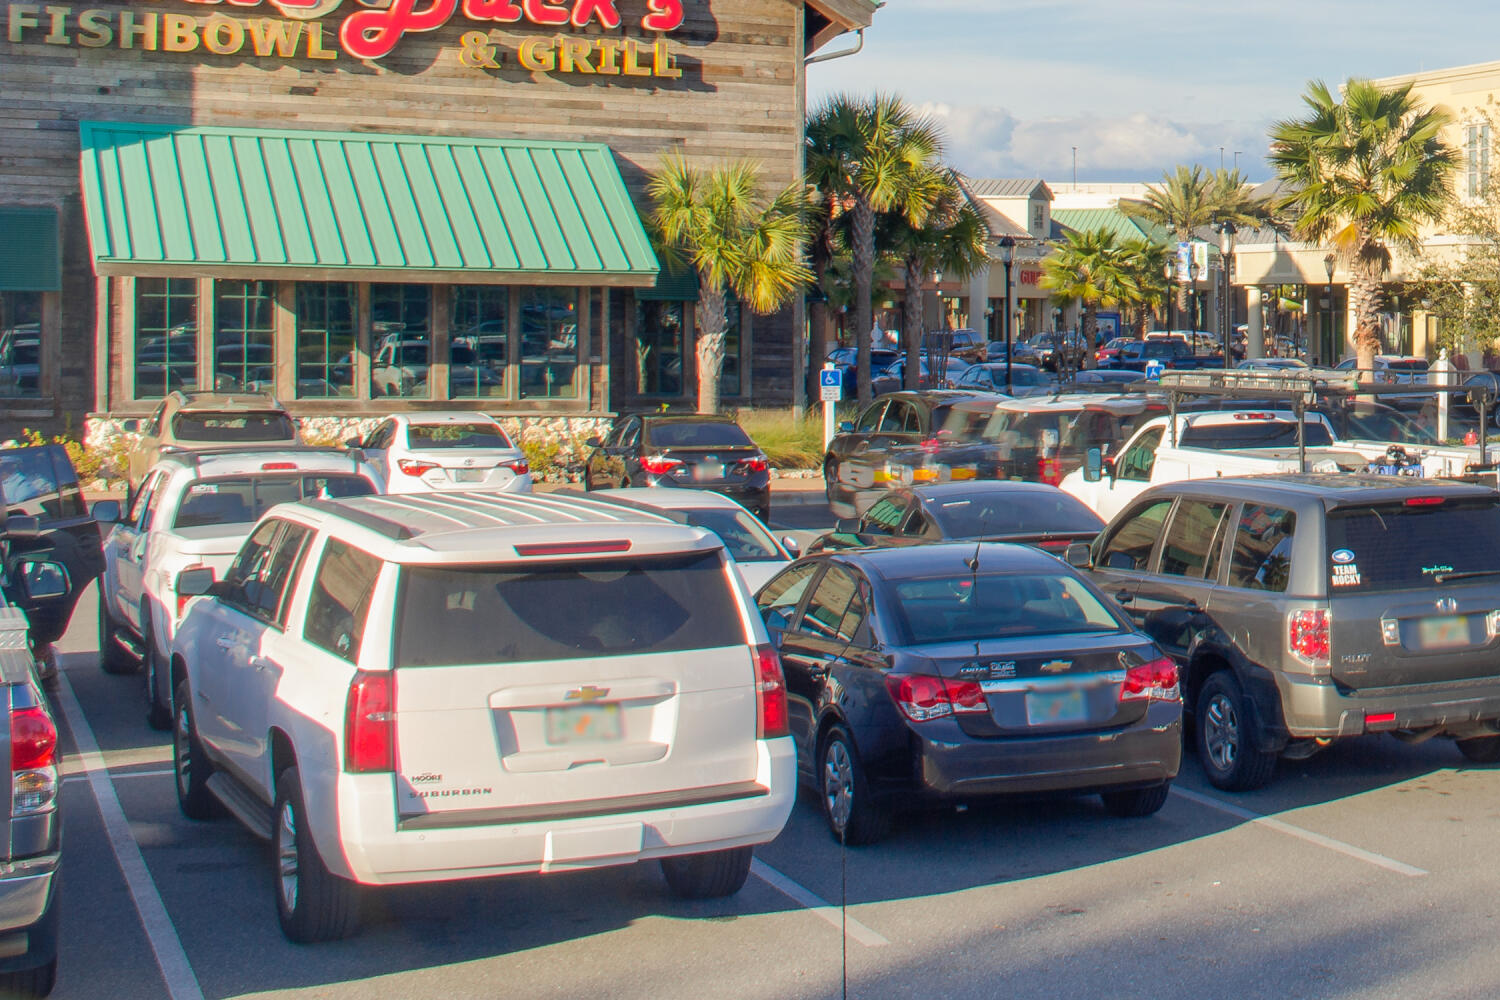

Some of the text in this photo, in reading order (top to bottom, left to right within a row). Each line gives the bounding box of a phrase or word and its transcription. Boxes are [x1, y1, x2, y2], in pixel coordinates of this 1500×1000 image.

[8, 4, 683, 78] FISHBOWL & GRILL
[1333, 564, 1358, 575] TEAM
[1332, 573, 1361, 586] ROCKY
[409, 787, 493, 798] SUBURBAN
